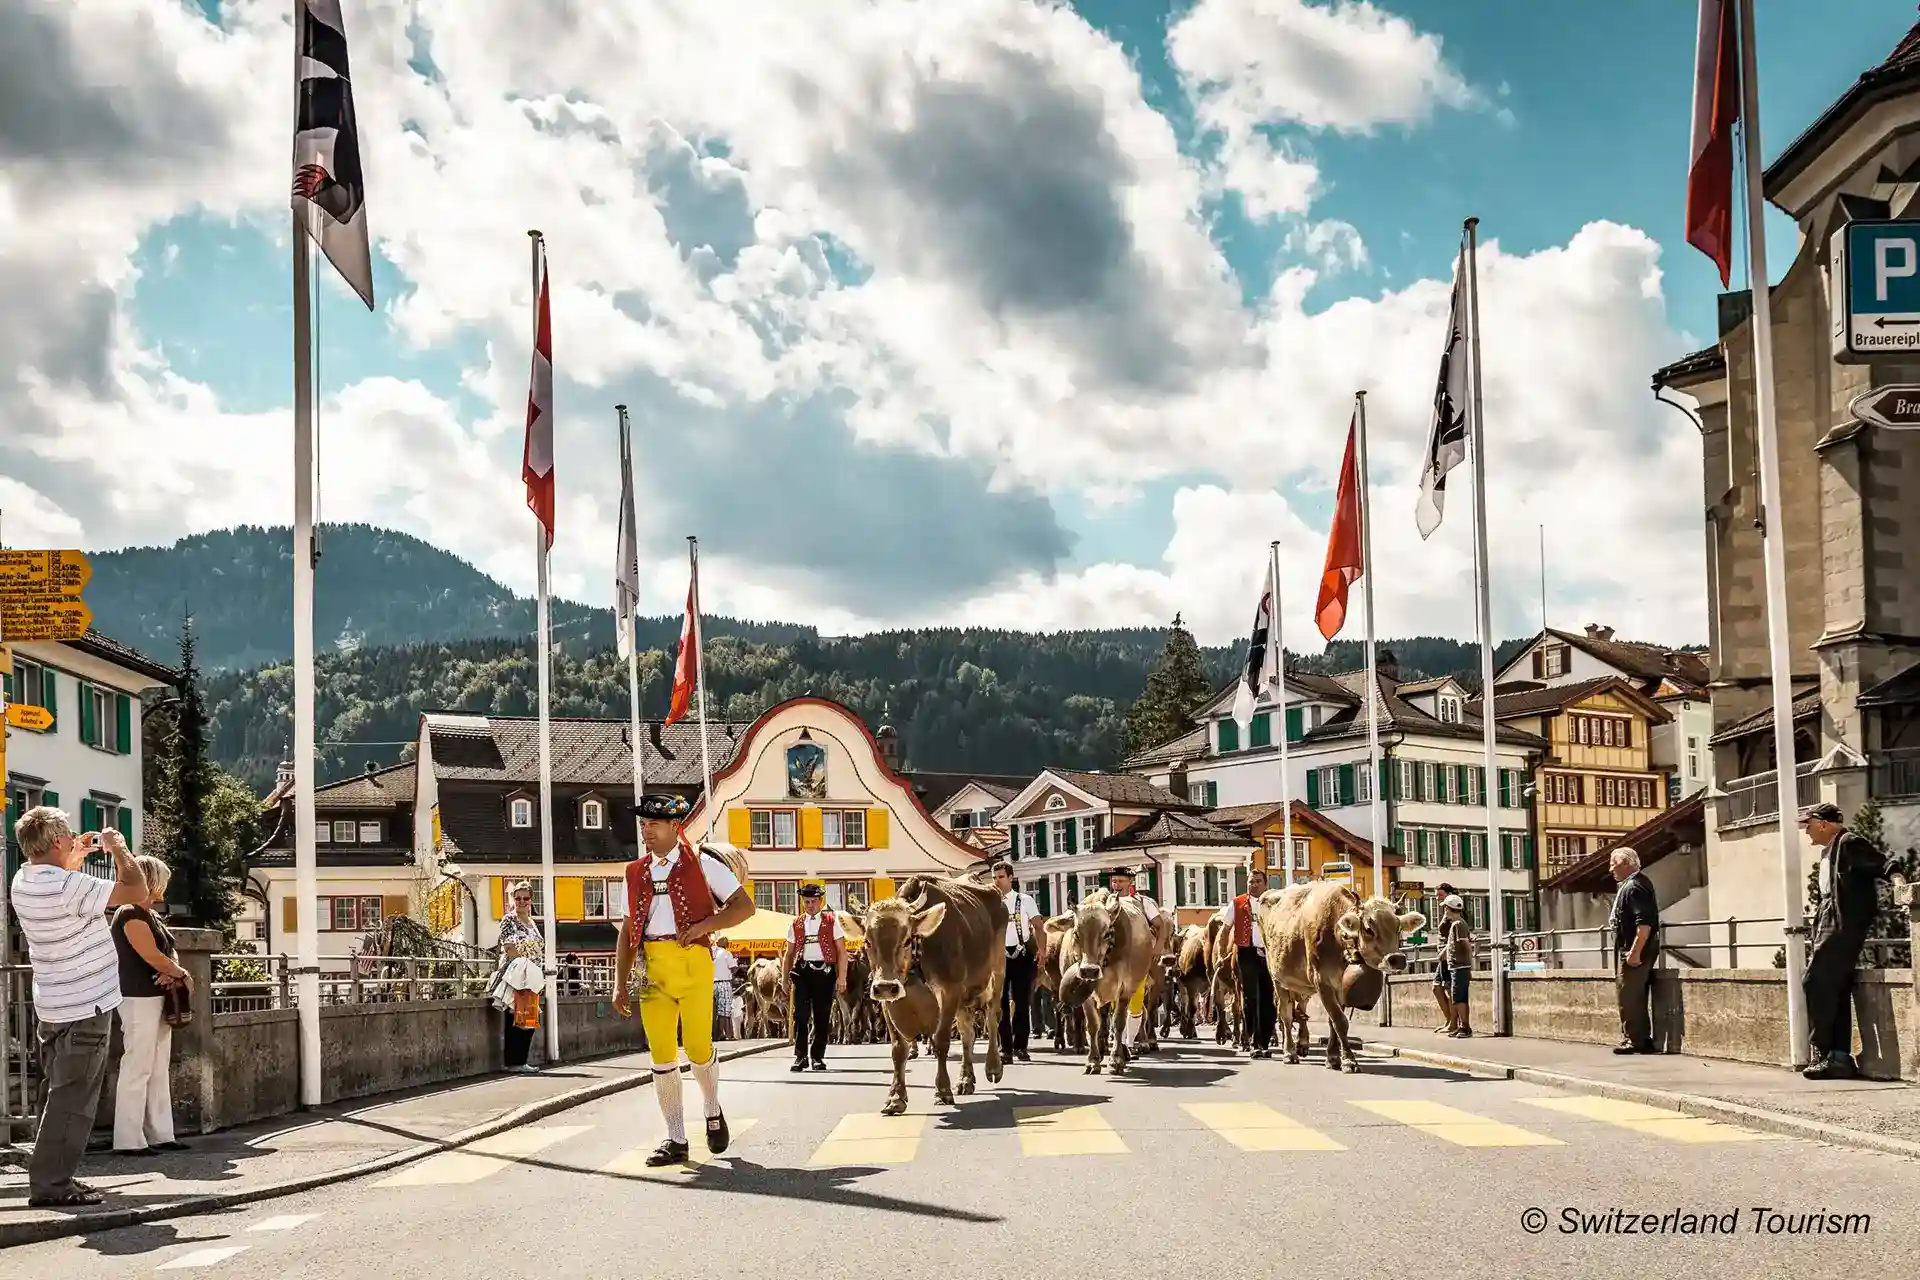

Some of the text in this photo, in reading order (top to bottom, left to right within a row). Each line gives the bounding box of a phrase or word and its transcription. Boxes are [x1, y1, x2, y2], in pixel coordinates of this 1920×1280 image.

[1875, 237, 1918, 301] P
[1855, 331, 1920, 348] Brauereipl
[1894, 398, 1920, 415] Bra
[749, 941, 771, 949] Hotel
